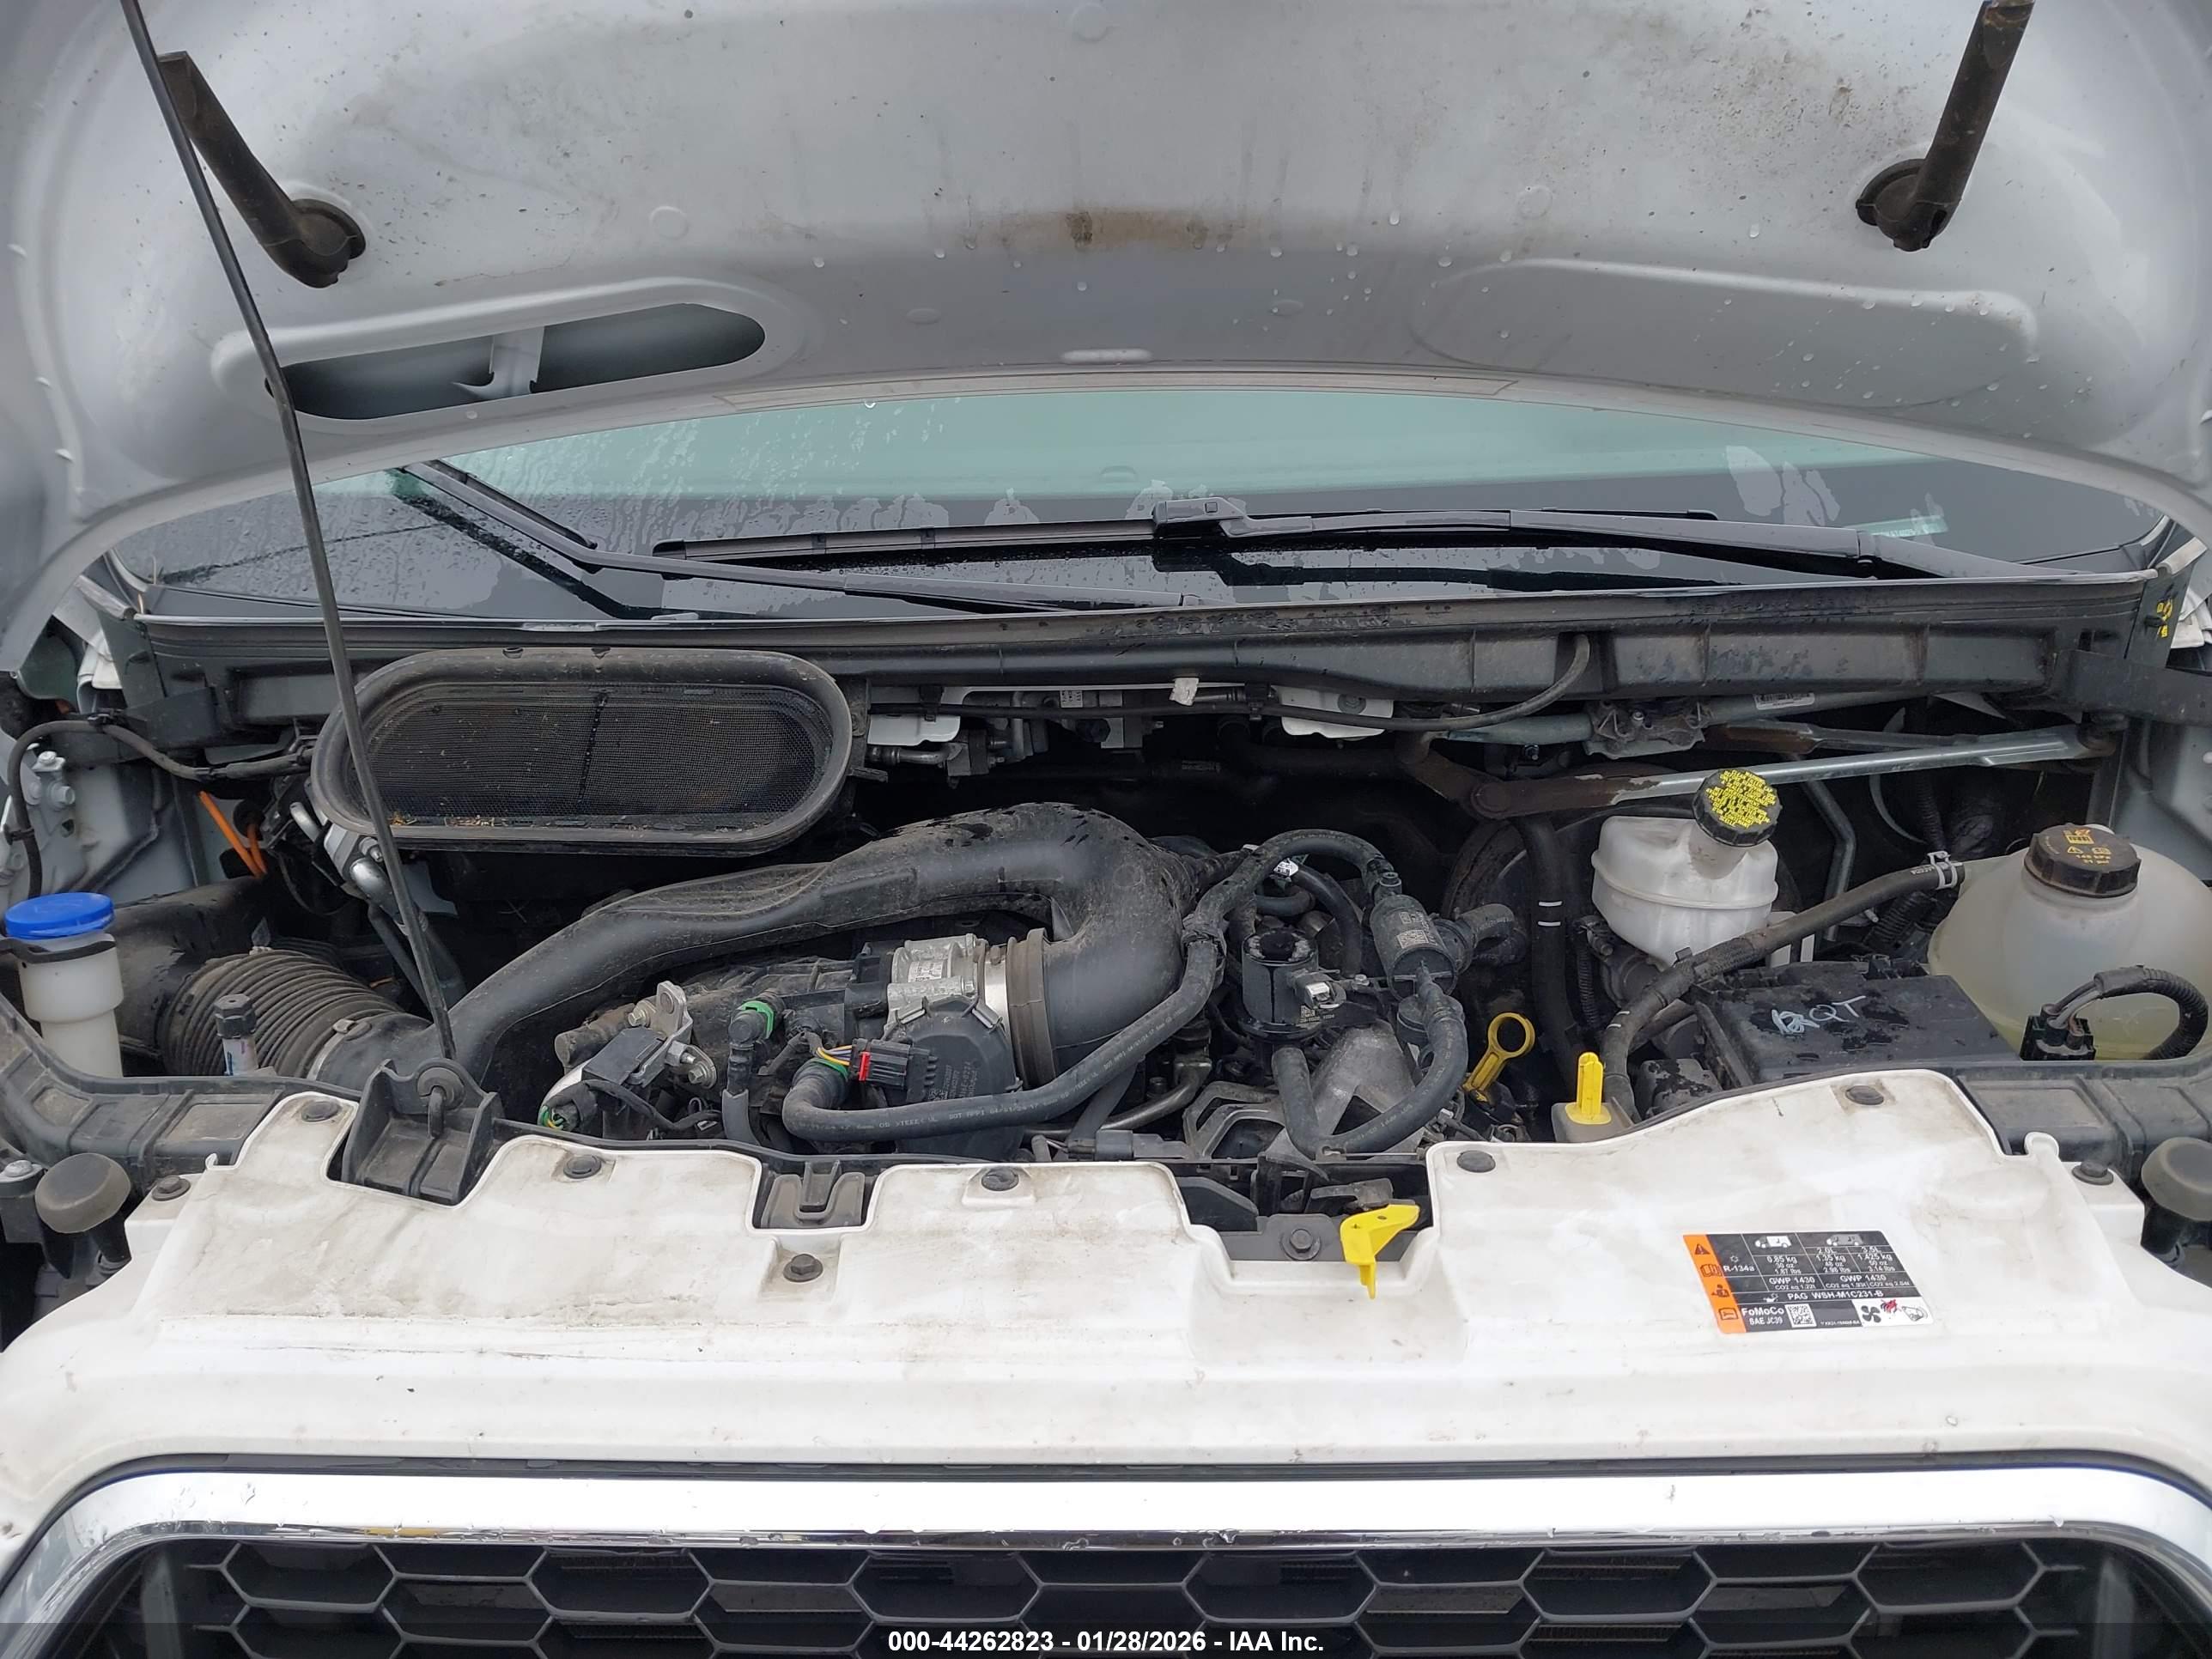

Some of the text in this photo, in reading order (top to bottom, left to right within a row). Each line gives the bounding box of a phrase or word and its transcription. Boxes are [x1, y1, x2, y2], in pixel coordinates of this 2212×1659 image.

[1785, 1255, 1798, 1264] kg
[1833, 1253, 1846, 1262] kg
[1880, 1252, 1893, 1261] kg
[1811, 1290, 1884, 1299] WSH-M1C231-B
[1741, 1306, 1784, 1316] FoMoCo
